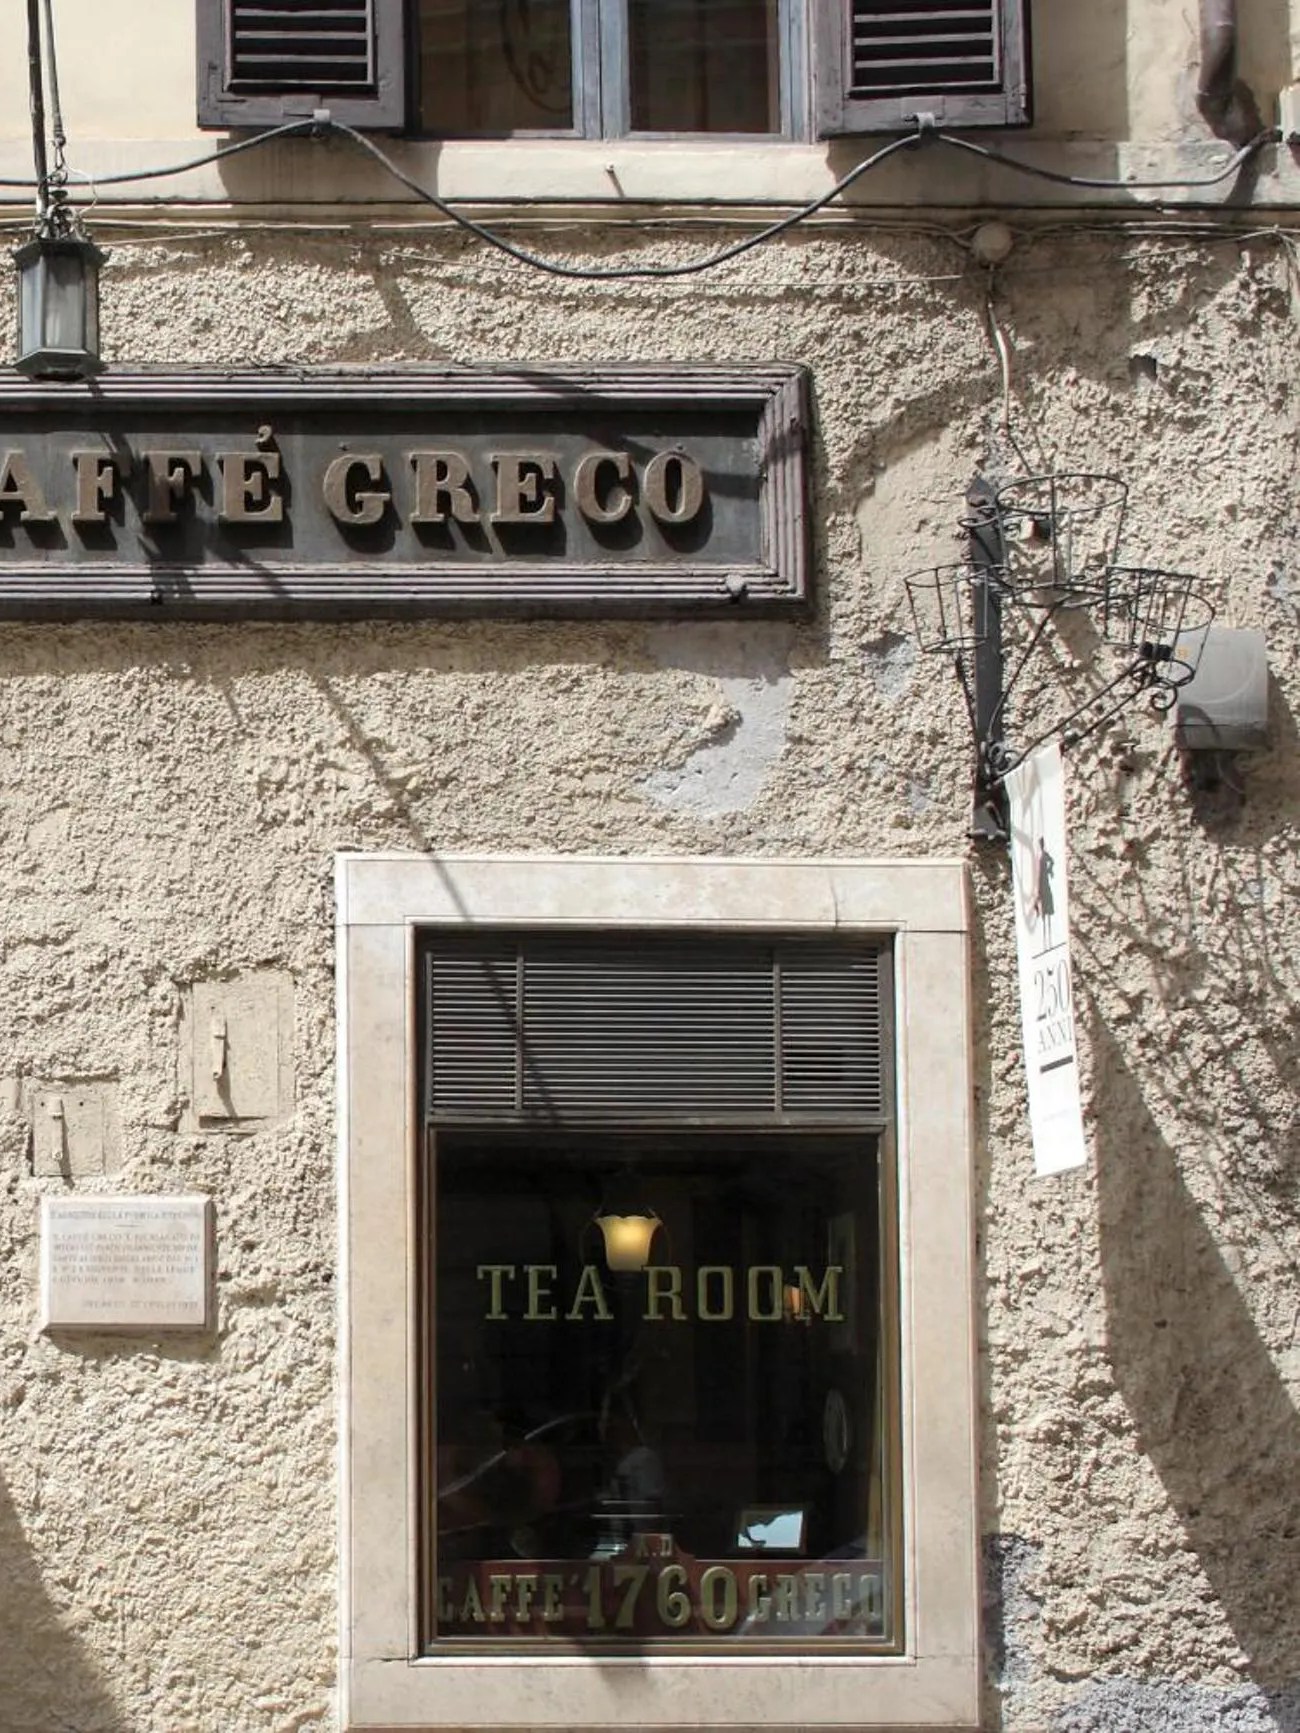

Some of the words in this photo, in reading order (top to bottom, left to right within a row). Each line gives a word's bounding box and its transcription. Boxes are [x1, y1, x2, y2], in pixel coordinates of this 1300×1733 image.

[322, 447, 702, 526] GRECO
[1034, 959, 1070, 1021] 250
[1036, 1015, 1074, 1055] ANNI
[476, 1265, 614, 1321] TEA
[641, 1265, 844, 1322] ROOM
[582, 1563, 738, 1630] 1760
[747, 1572, 882, 1623] GRECO
